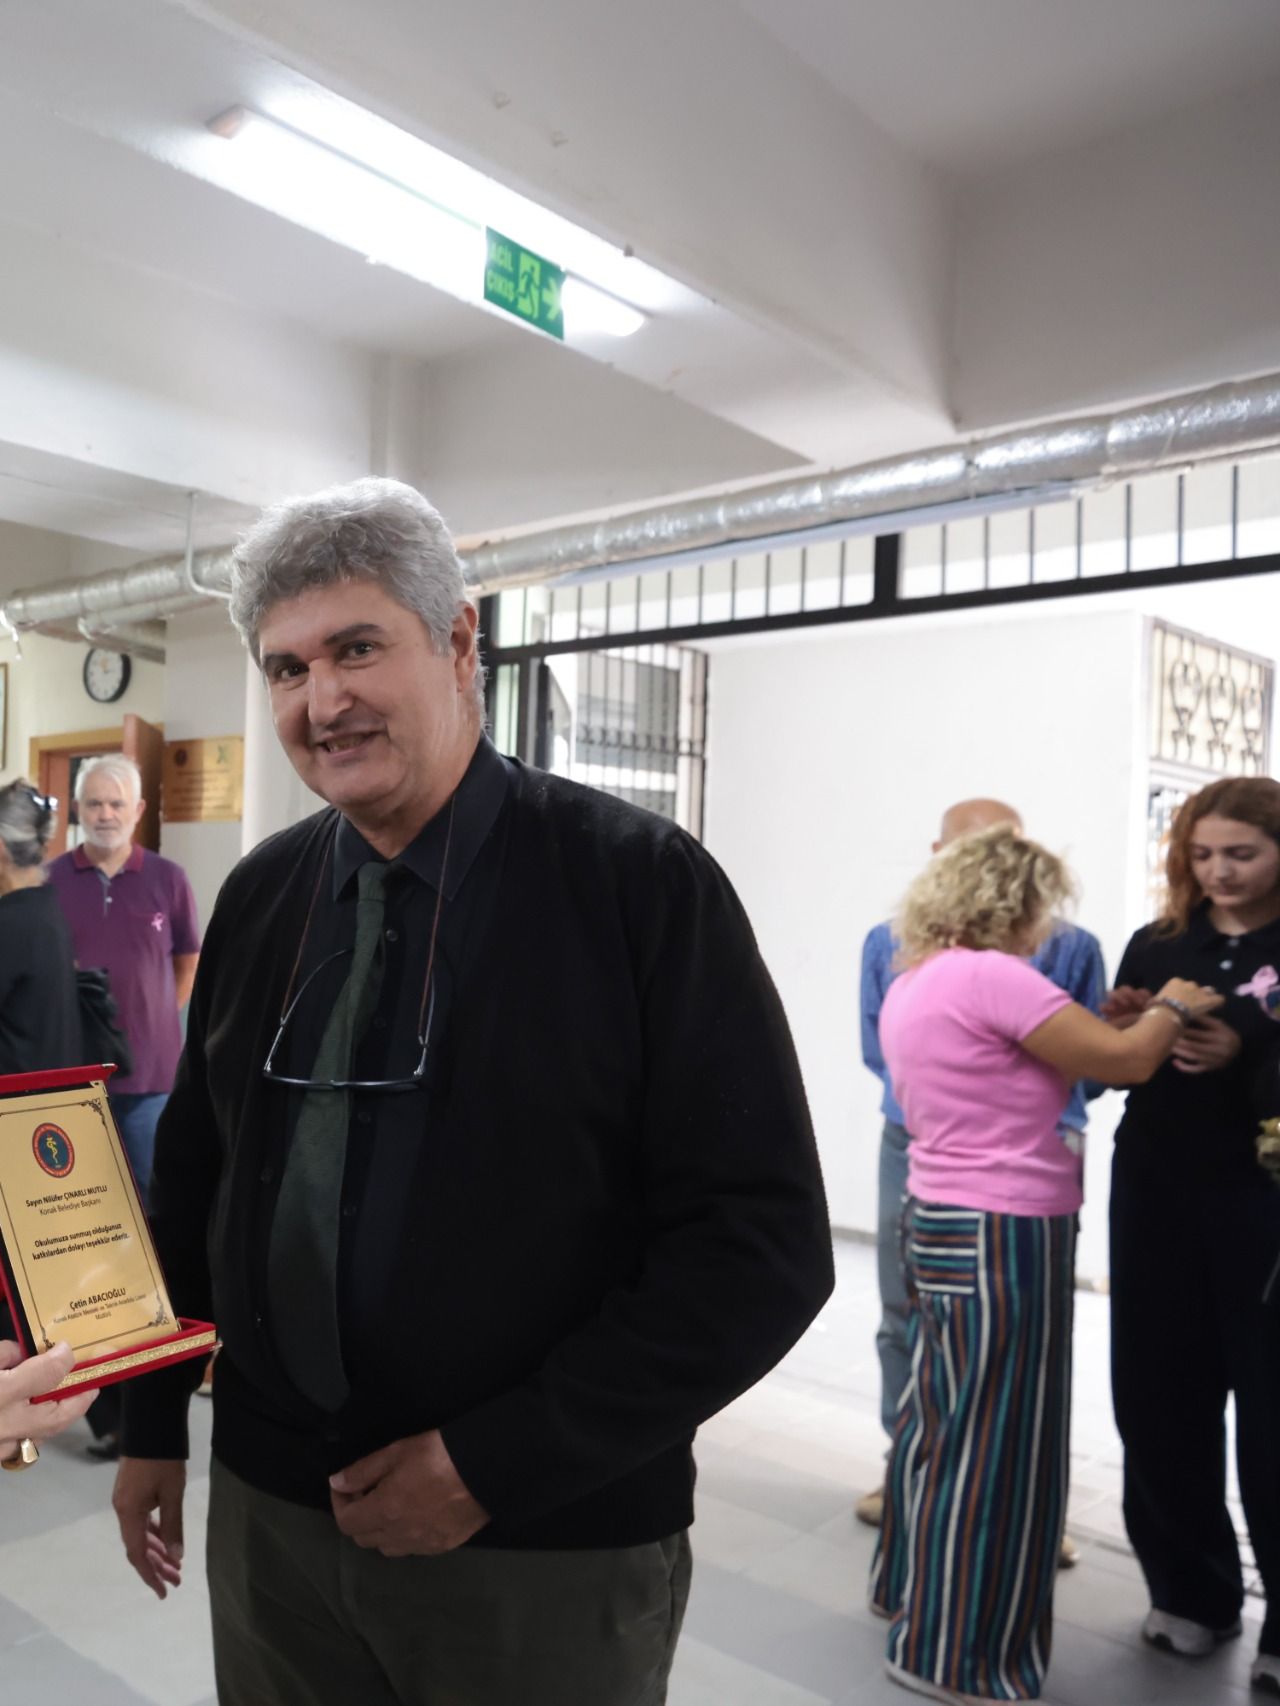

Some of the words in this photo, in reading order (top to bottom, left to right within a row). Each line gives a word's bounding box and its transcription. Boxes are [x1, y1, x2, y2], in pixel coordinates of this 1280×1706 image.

[25, 1198, 43, 1208] Sayın
[43, 1193, 63, 1205] Nilüfer
[63, 1188, 87, 1202] ÇINARLI
[87, 1184, 108, 1196] MUTLU
[34, 1234, 69, 1248] Okulumuza
[68, 1229, 92, 1242] sunmuş
[92, 1222, 122, 1236] olduğunuz
[67, 1242, 86, 1254] dolayı
[86, 1236, 110, 1249] teşekkür
[69, 1300, 87, 1311] Çetin
[87, 1287, 127, 1305] ABACIOĞLU
